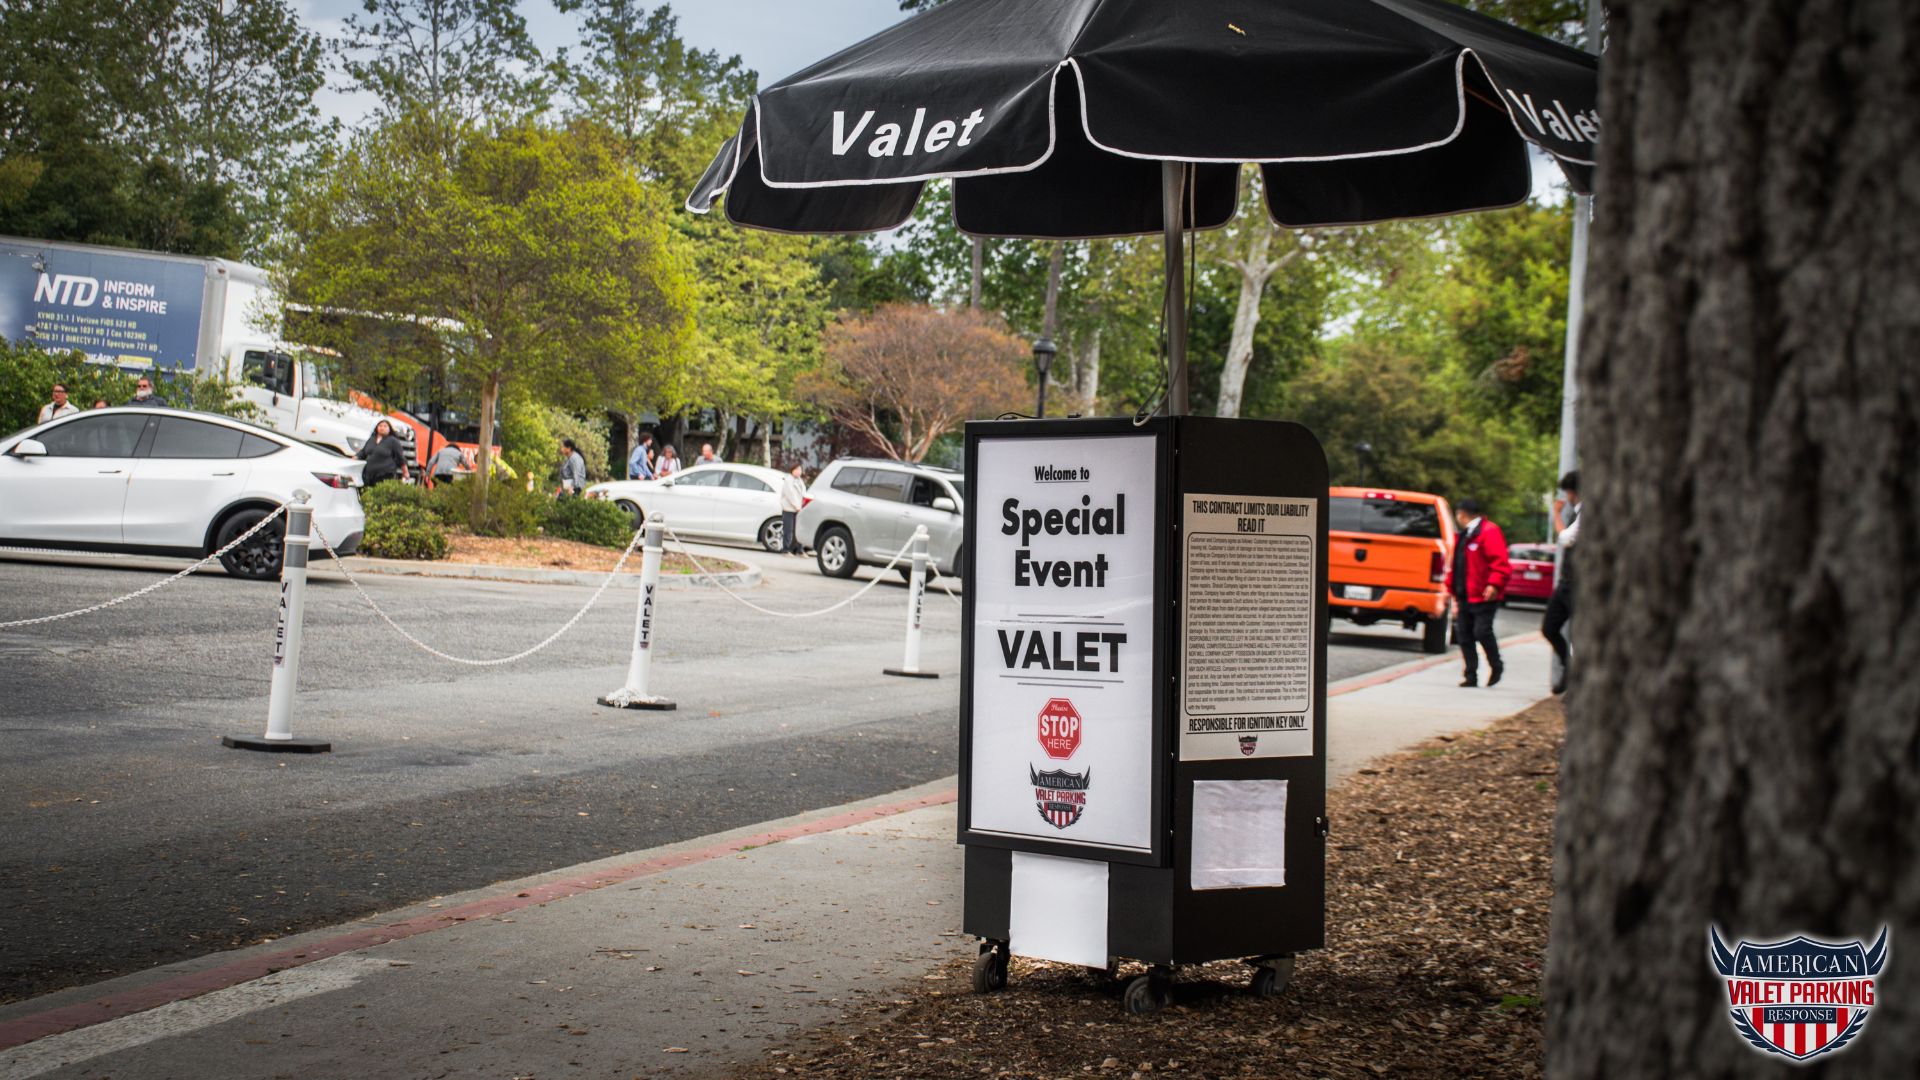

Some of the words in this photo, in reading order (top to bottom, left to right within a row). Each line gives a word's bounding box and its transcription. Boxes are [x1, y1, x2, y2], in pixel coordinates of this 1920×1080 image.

[832, 107, 985, 158] Valet
[34, 272, 99, 307] NTD
[103, 280, 155, 298] INFORM
[102, 295, 113, 309] &
[115, 297, 167, 314] INSPIRE
[1034, 464, 1077, 481] Welcome
[1080, 466, 1090, 481] to
[1192, 500, 1208, 514] THIS
[1208, 502, 1242, 515] CONTRACT
[1244, 503, 1265, 516] LIMITS
[1266, 504, 1280, 516] OUR
[1280, 504, 1309, 517] LIABILITY
[1001, 493, 1125, 547] Special
[1238, 518, 1257, 532] READ
[1258, 518, 1266, 532] IT
[1014, 550, 1108, 588] Event
[915, 581, 926, 623] VALET
[275, 582, 288, 654] VALET
[640, 585, 654, 642] VALET
[998, 630, 1128, 673] VALET
[1040, 714, 1079, 738] STOP
[1188, 718, 1232, 732] RESPONSIBLE
[1234, 718, 1246, 730] FOR
[1247, 716, 1274, 730] IGNITION
[1276, 716, 1288, 728] KEY
[1288, 715, 1305, 728] ONLY
[1047, 738, 1072, 750] HERE
[1038, 775, 1082, 790] AMERICAN
[1036, 788, 1056, 802] VALET
[1056, 791, 1086, 805] PARKING
